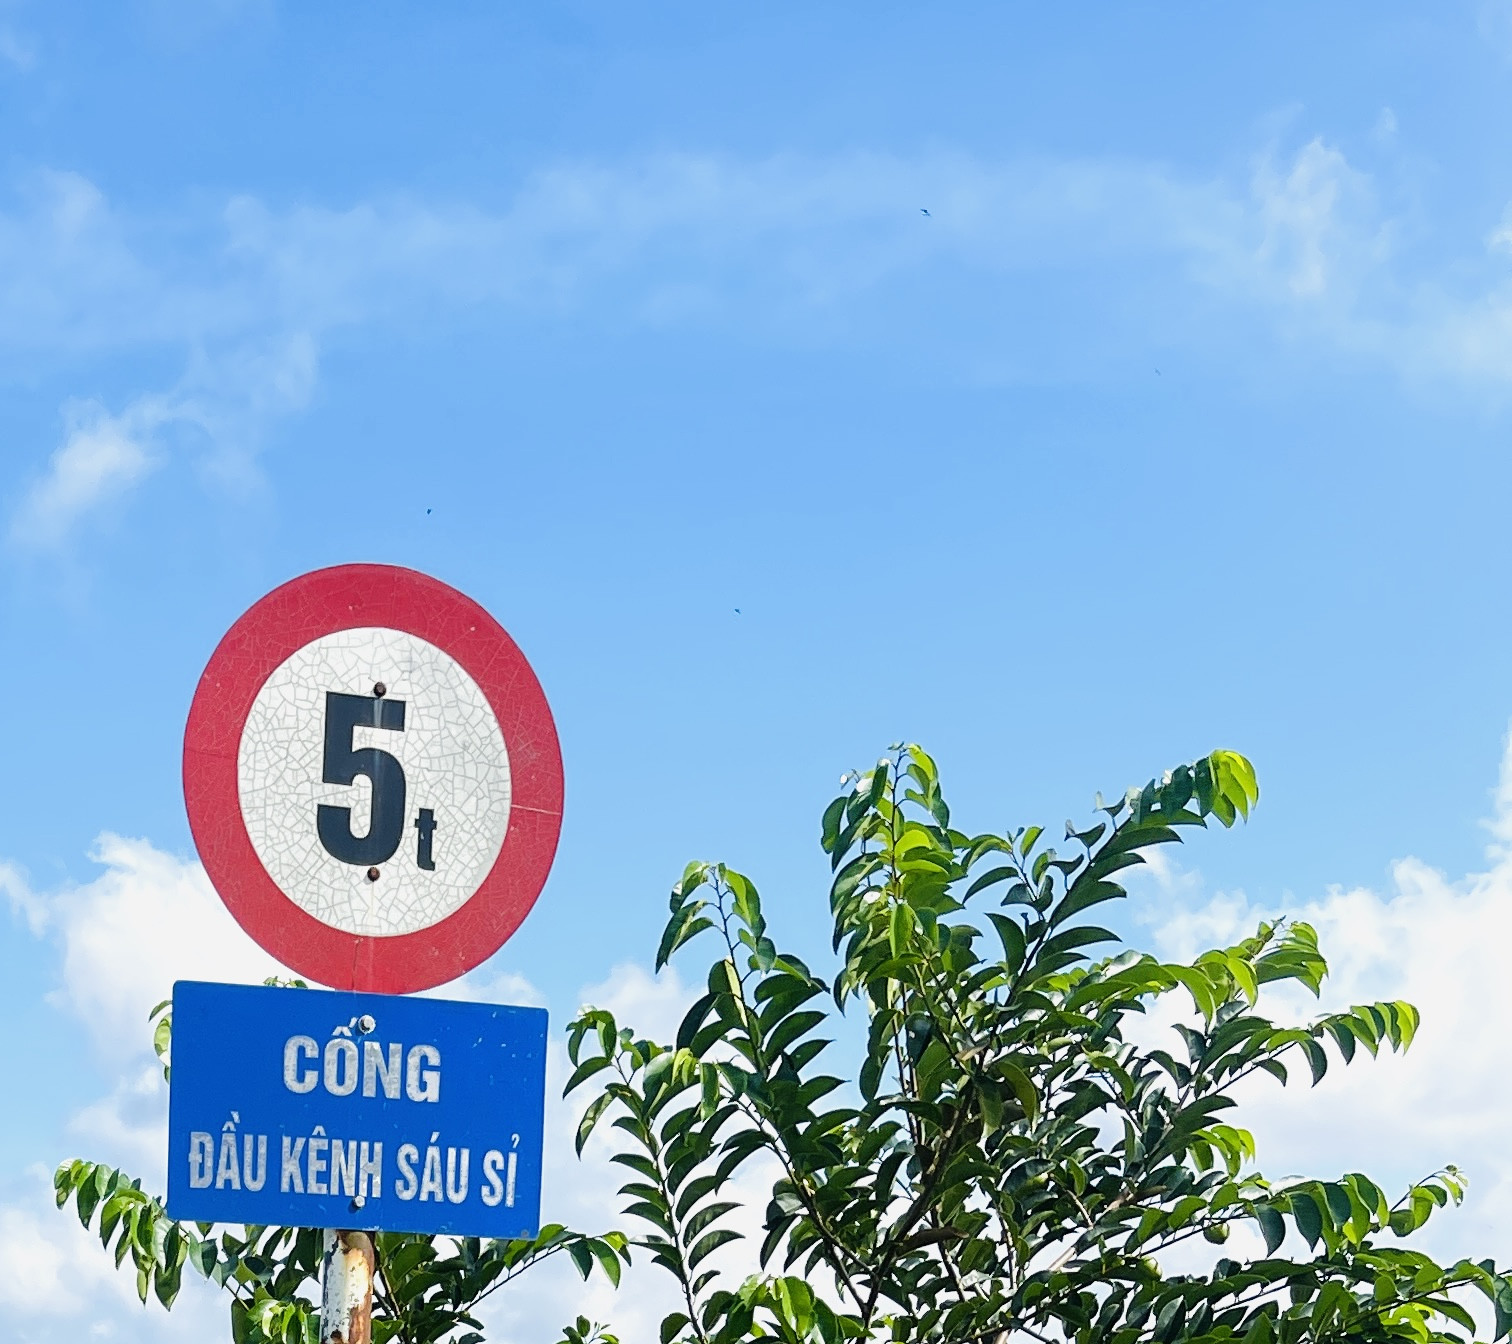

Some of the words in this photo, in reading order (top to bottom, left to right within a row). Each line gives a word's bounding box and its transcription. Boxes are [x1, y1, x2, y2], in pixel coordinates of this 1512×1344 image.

[316, 690, 438, 871] 5t
[283, 1016, 441, 1103] CỐNG
[188, 1111, 268, 1192] ĐẦU
[280, 1125, 383, 1198] KÊNH
[394, 1132, 470, 1204] SÁU
[481, 1133, 520, 1208] SỈ
